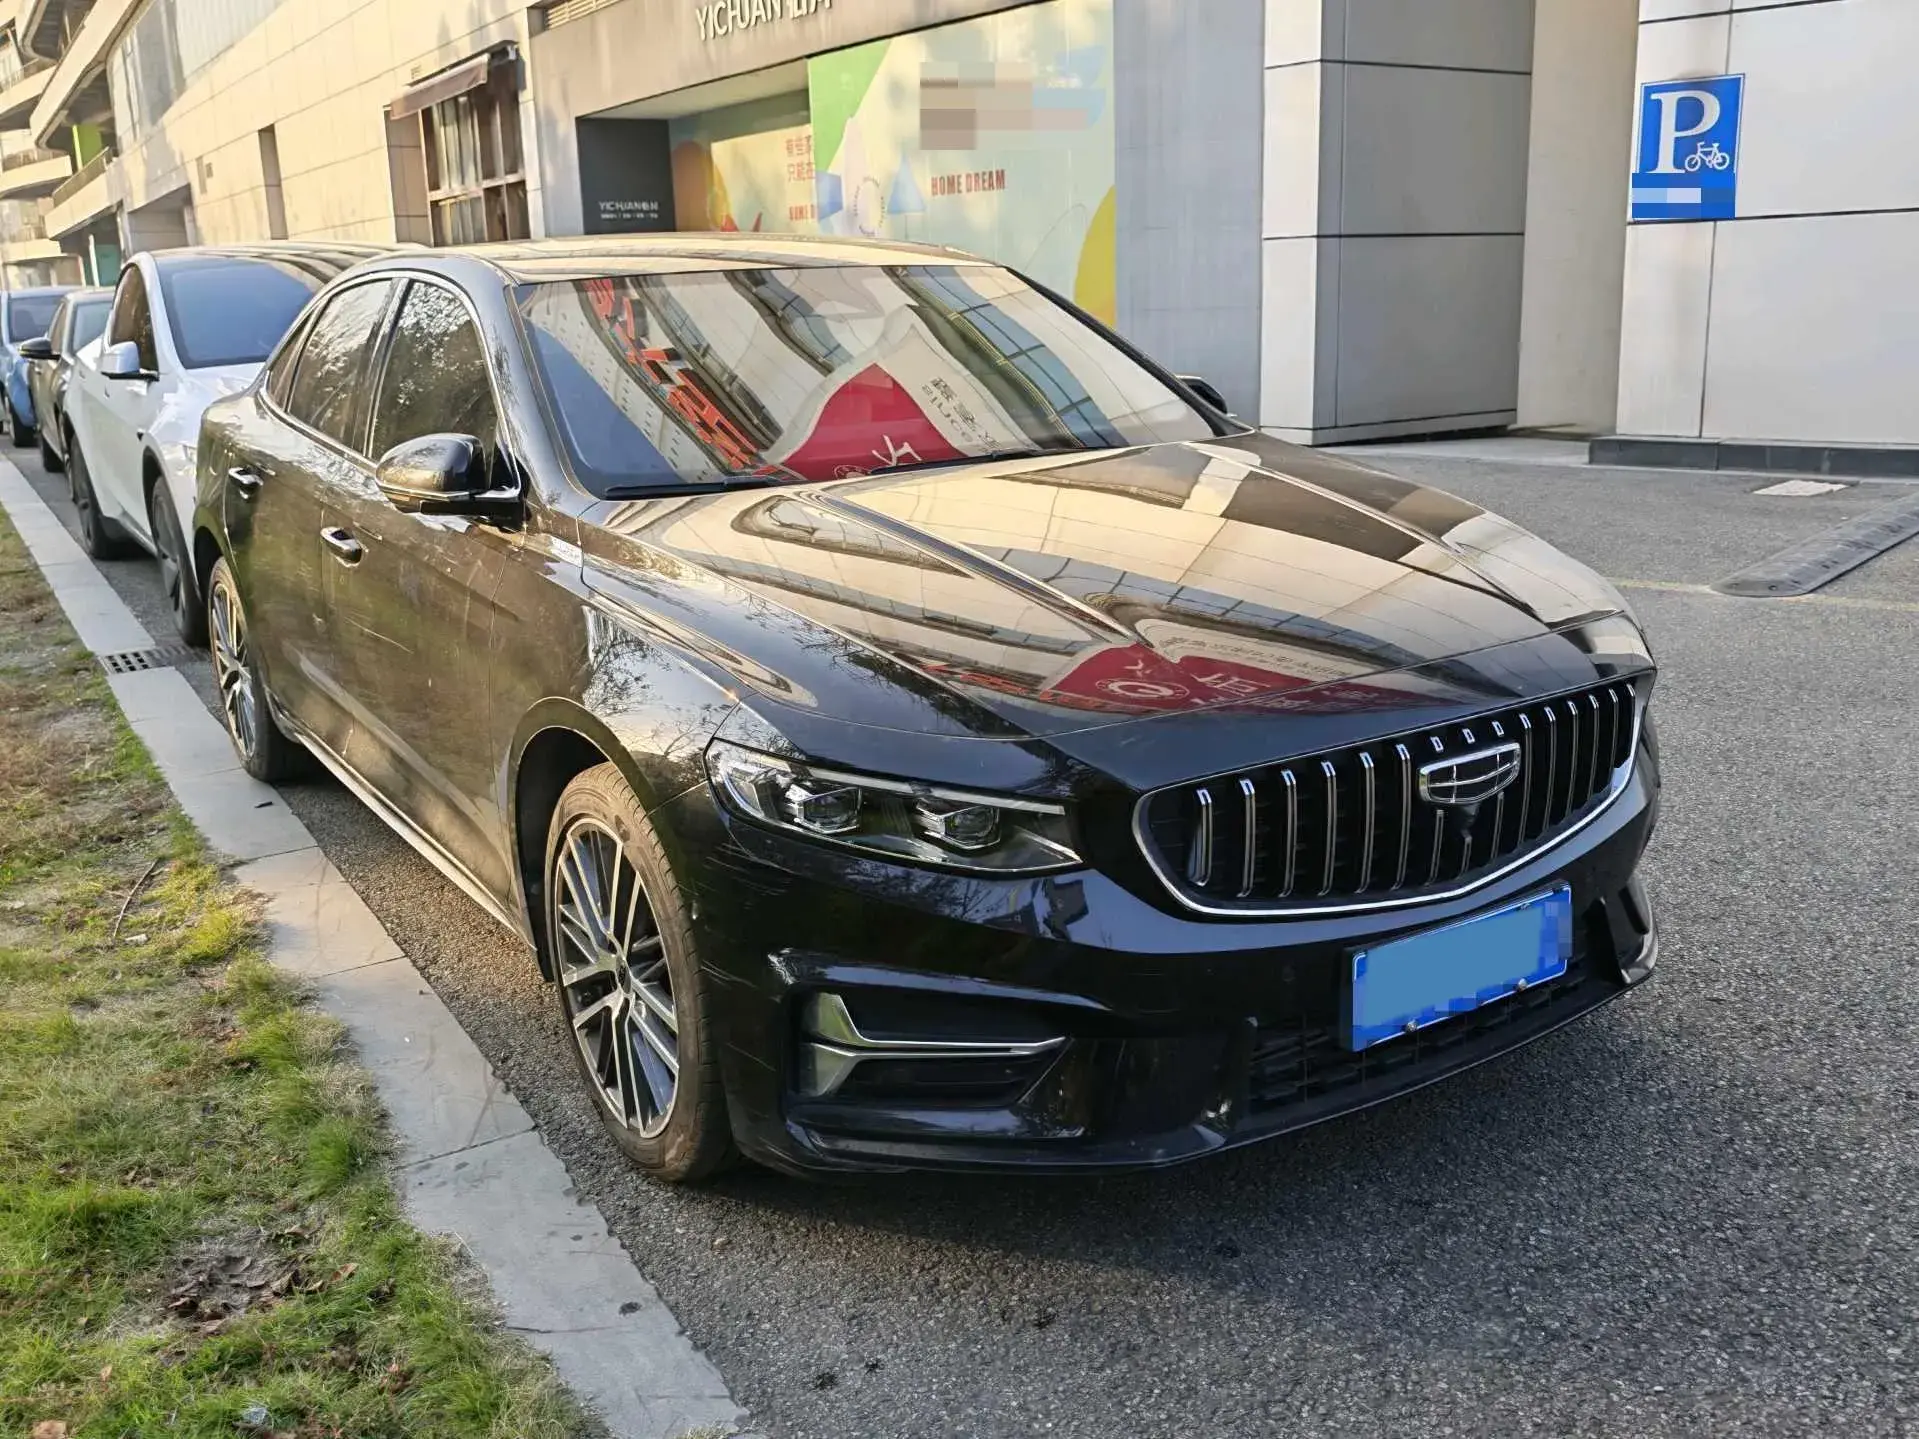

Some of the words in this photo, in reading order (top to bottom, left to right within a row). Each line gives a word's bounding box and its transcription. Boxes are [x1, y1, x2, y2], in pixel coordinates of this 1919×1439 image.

[1647, 89, 1721, 174] P
[931, 174, 963, 196] HOME
[965, 169, 1006, 192] DREAM
